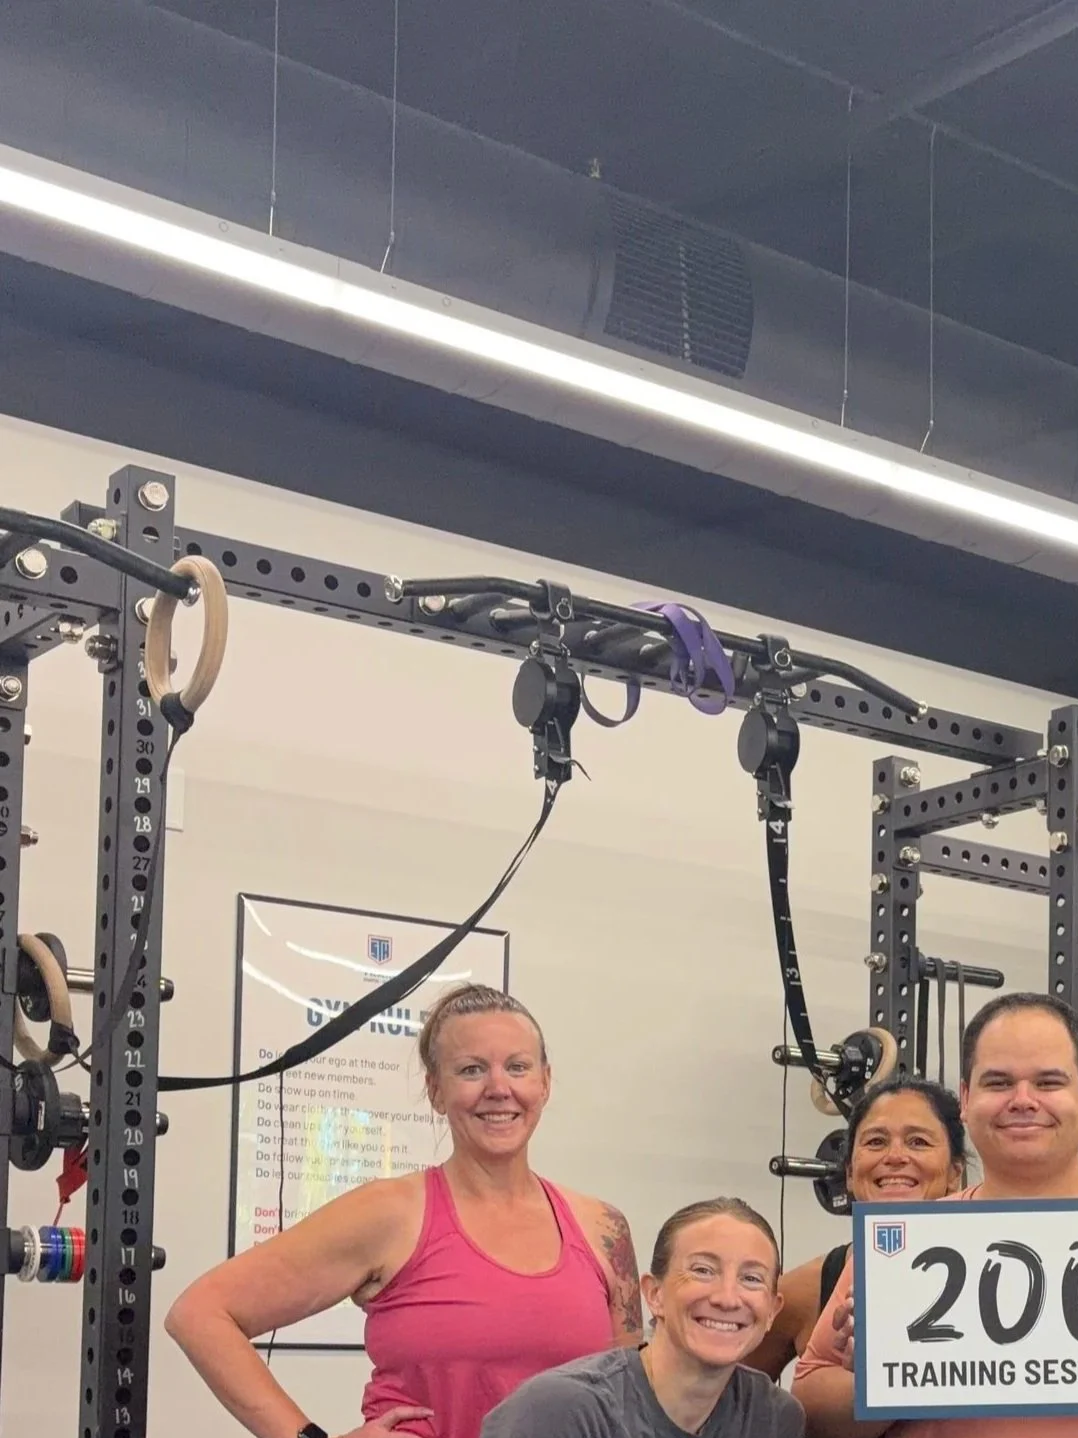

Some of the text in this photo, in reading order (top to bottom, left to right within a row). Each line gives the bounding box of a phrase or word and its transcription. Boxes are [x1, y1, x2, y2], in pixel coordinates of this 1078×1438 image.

[137, 699, 151, 717] 31
[136, 739, 154, 754] 30
[134, 777, 151, 794] 29
[134, 816, 151, 832] 28
[132, 856, 151, 871] 27
[127, 1011, 145, 1028] 23
[125, 1050, 145, 1068] 22
[328, 1056, 347, 1068] ego
[349, 1058, 358, 1067] at
[360, 1059, 378, 1069] the
[304, 1070, 326, 1080] new
[258, 1082, 272, 1093] Do
[303, 1089, 316, 1098] up
[318, 1090, 332, 1098] on
[125, 1092, 141, 1106] 21
[257, 1099, 271, 1110] Do
[391, 1112, 411, 1122] your
[257, 1117, 271, 1127] Do
[124, 1129, 144, 1146] 20
[342, 1139, 358, 1149] like
[360, 1142, 378, 1153] you
[256, 1150, 270, 1161] Do
[123, 1169, 138, 1188] 19
[256, 1167, 269, 1178] Do
[287, 1171, 304, 1180] our
[122, 1210, 139, 1225] 18
[121, 1248, 135, 1265] 17
[118, 1287, 136, 1304] 16
[117, 1368, 134, 1385] 14
[882, 1360, 1016, 1388] TRAINING
[115, 1408, 131, 1425] 13
